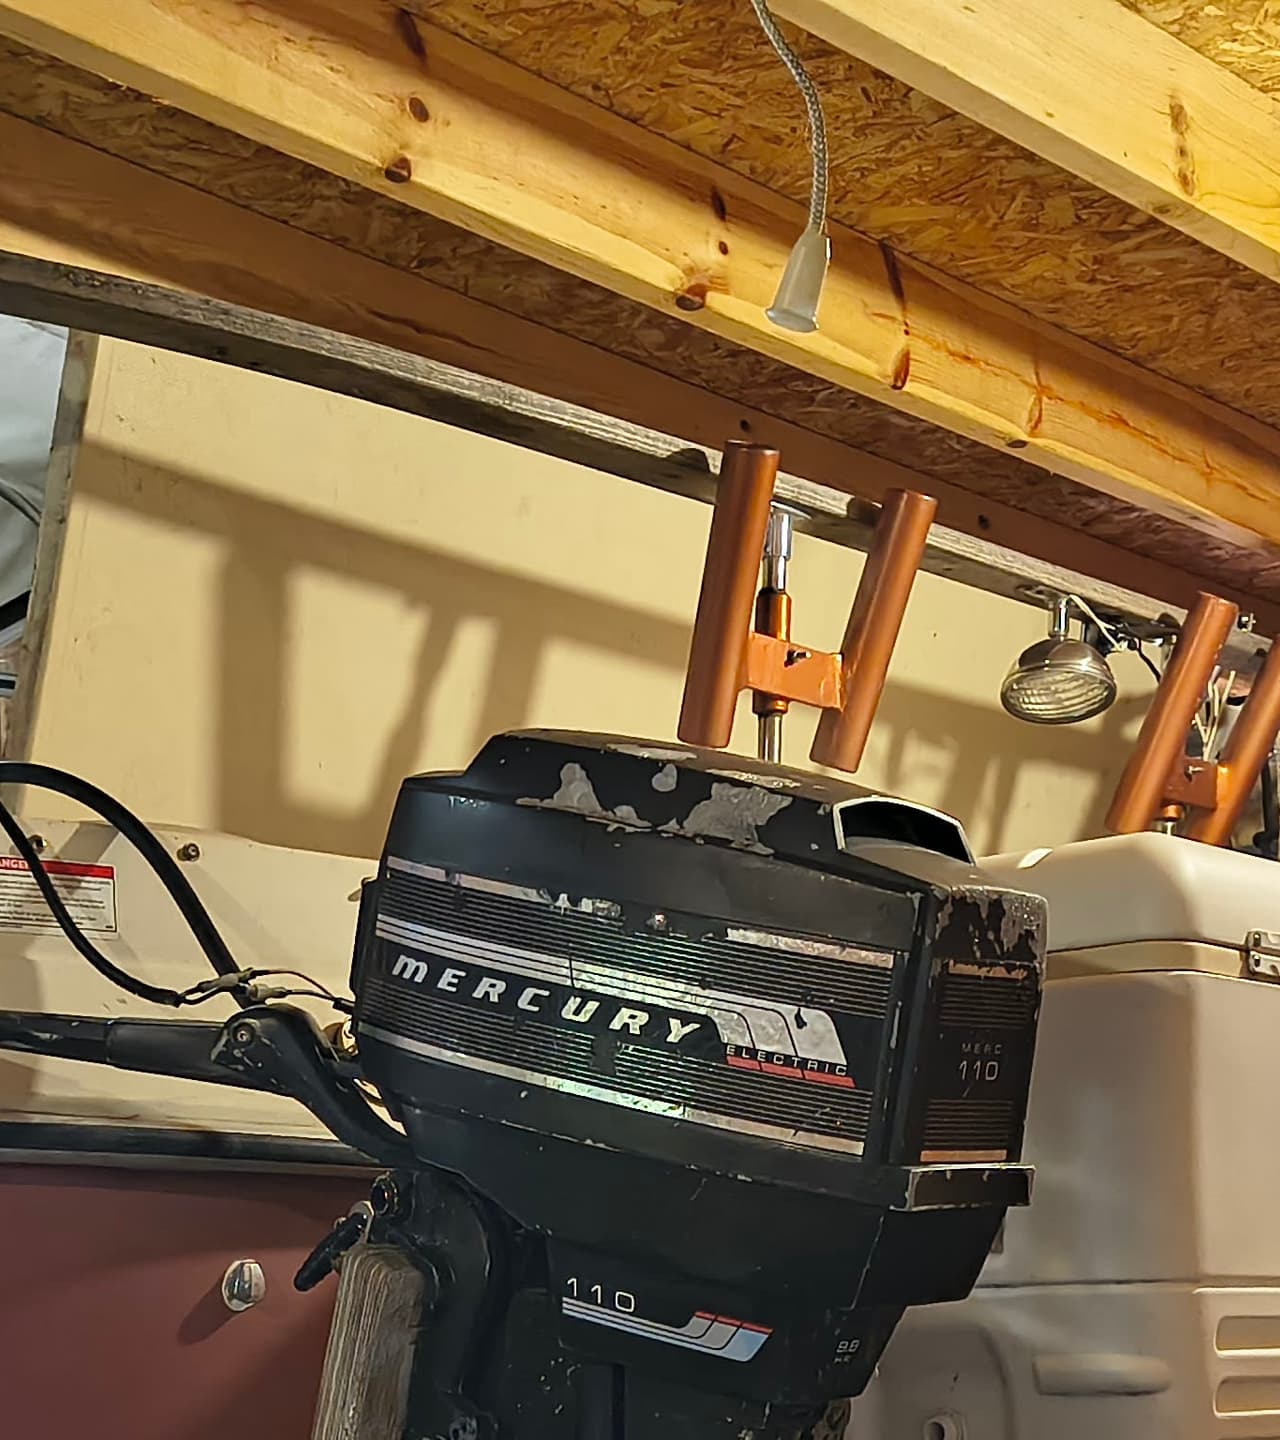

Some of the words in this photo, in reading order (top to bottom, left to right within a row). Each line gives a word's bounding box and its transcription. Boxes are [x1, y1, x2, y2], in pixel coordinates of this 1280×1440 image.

[391, 953, 701, 1045] MERCURY
[725, 1043, 848, 1077] ELECTRIC
[961, 1042, 1003, 1054] MERC
[958, 1060, 999, 1081] 110
[566, 1277, 635, 1313] 110
